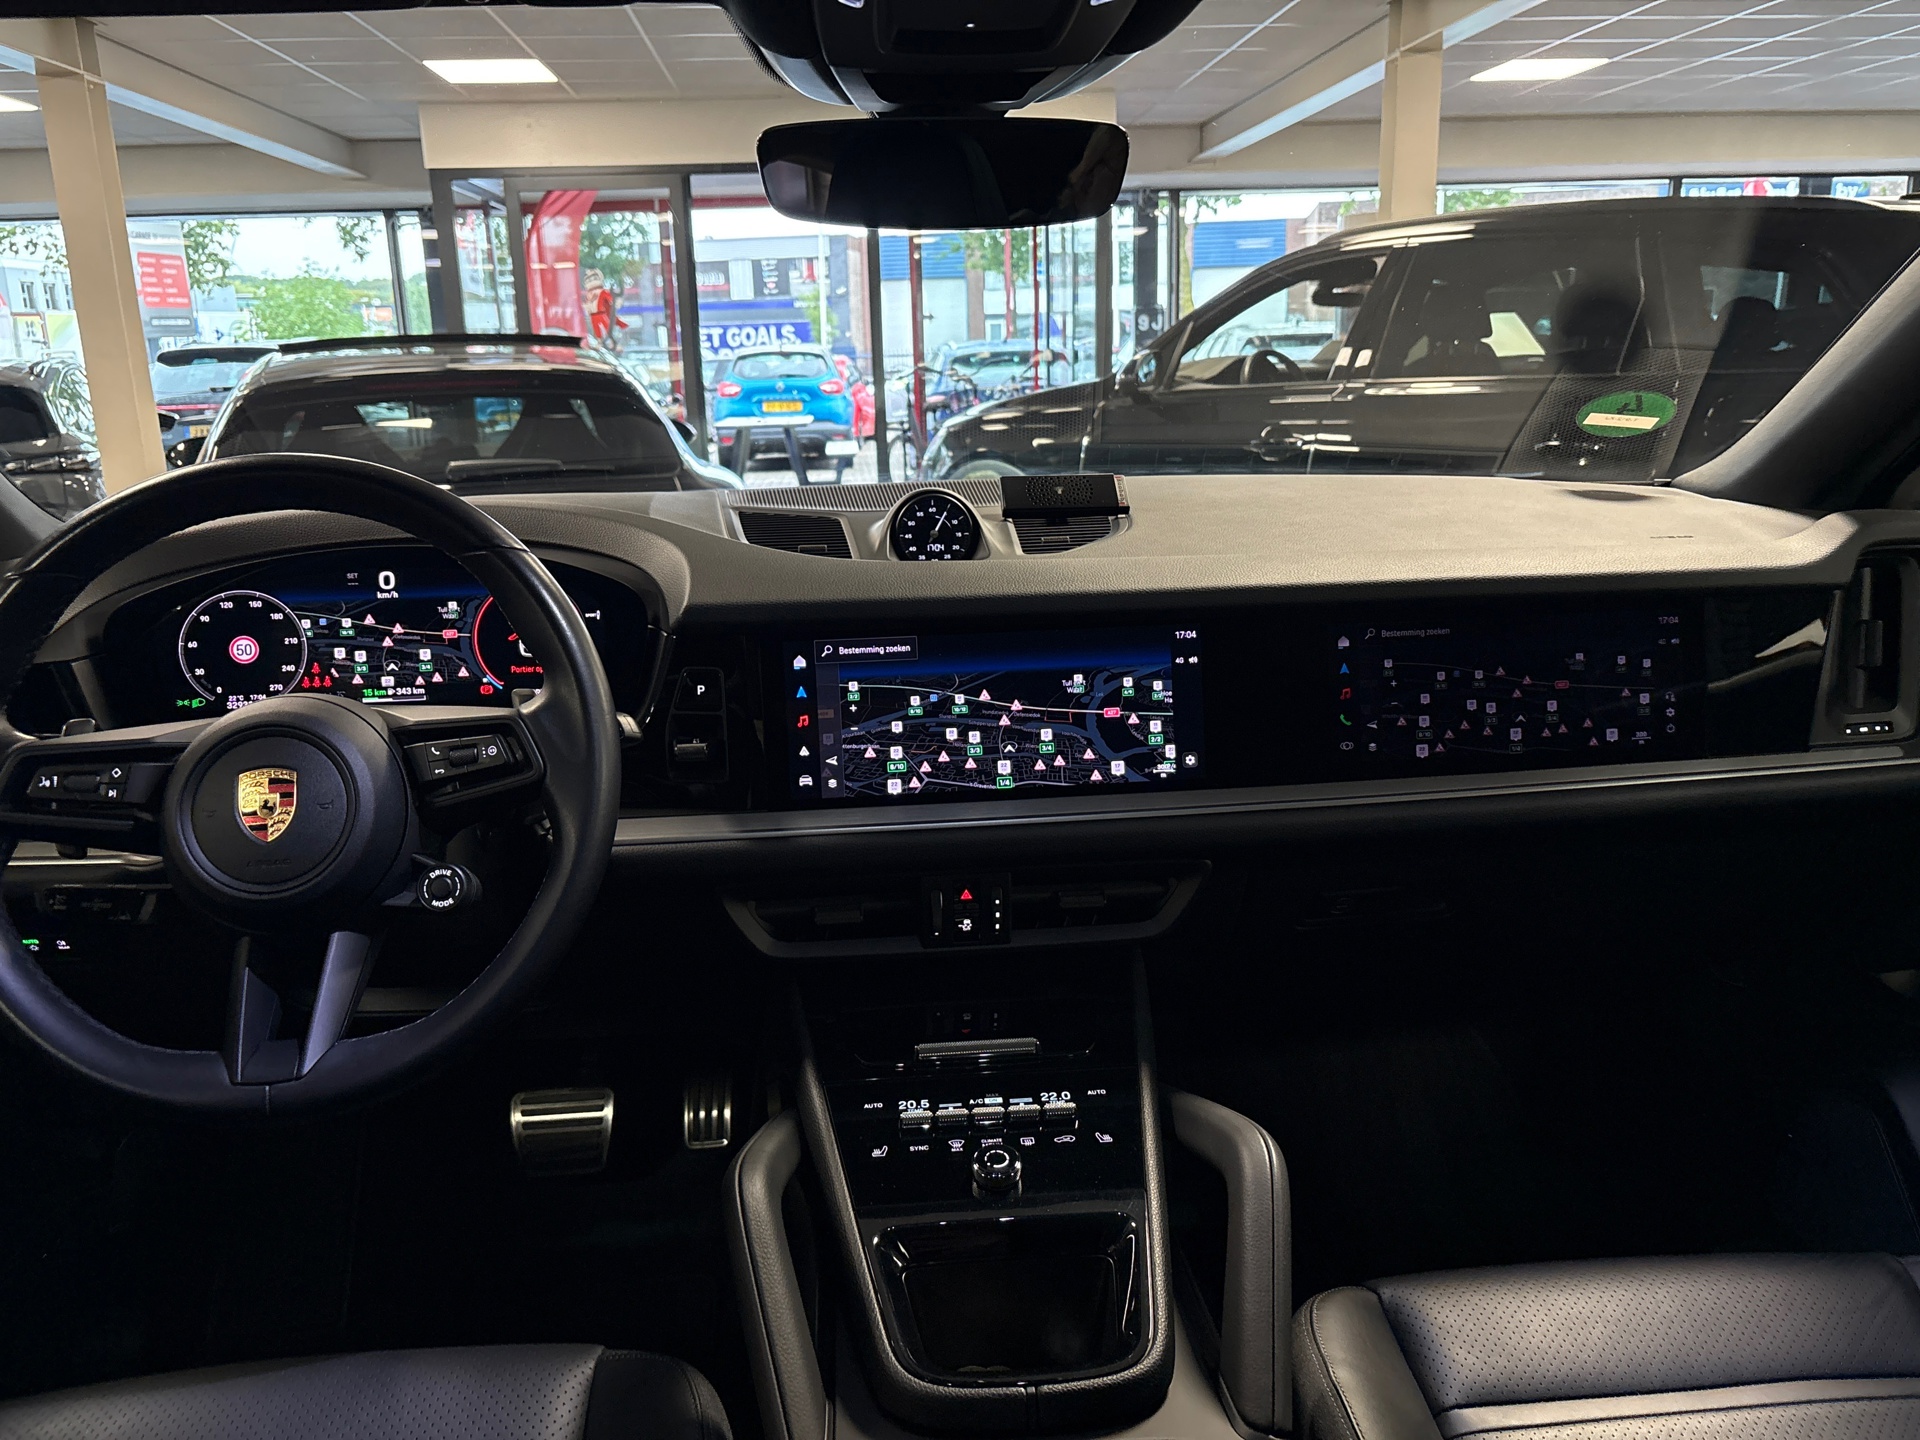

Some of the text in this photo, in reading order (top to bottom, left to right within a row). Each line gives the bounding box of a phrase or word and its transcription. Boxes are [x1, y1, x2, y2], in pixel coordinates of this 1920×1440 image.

[726, 324, 802, 347] GOALS.
[346, 572, 358, 580] SET
[378, 570, 396, 590] 0
[376, 591, 399, 599] km/h
[219, 601, 234, 609] 120
[248, 600, 262, 608] 150
[1174, 630, 1197, 639] 17:04
[1381, 628, 1450, 638] Bestemming zoeken
[284, 637, 298, 645] 210
[236, 644, 252, 656] 50
[838, 644, 911, 656] Bestemming zoeken
[1175, 656, 1184, 664] 4G
[194, 668, 205, 676] 30
[281, 664, 296, 672] 240
[511, 666, 535, 674] Portier
[216, 686, 222, 694] 0
[269, 684, 284, 692] 270
[374, 688, 387, 696] km
[412, 687, 425, 695] km
[696, 684, 706, 696] P
[240, 770, 296, 780] PORSCHE
[429, 868, 452, 879] DRIVE
[431, 898, 454, 908] MODE
[898, 1099, 930, 1110] 20.5
[1040, 1091, 1071, 1102] 22.0
